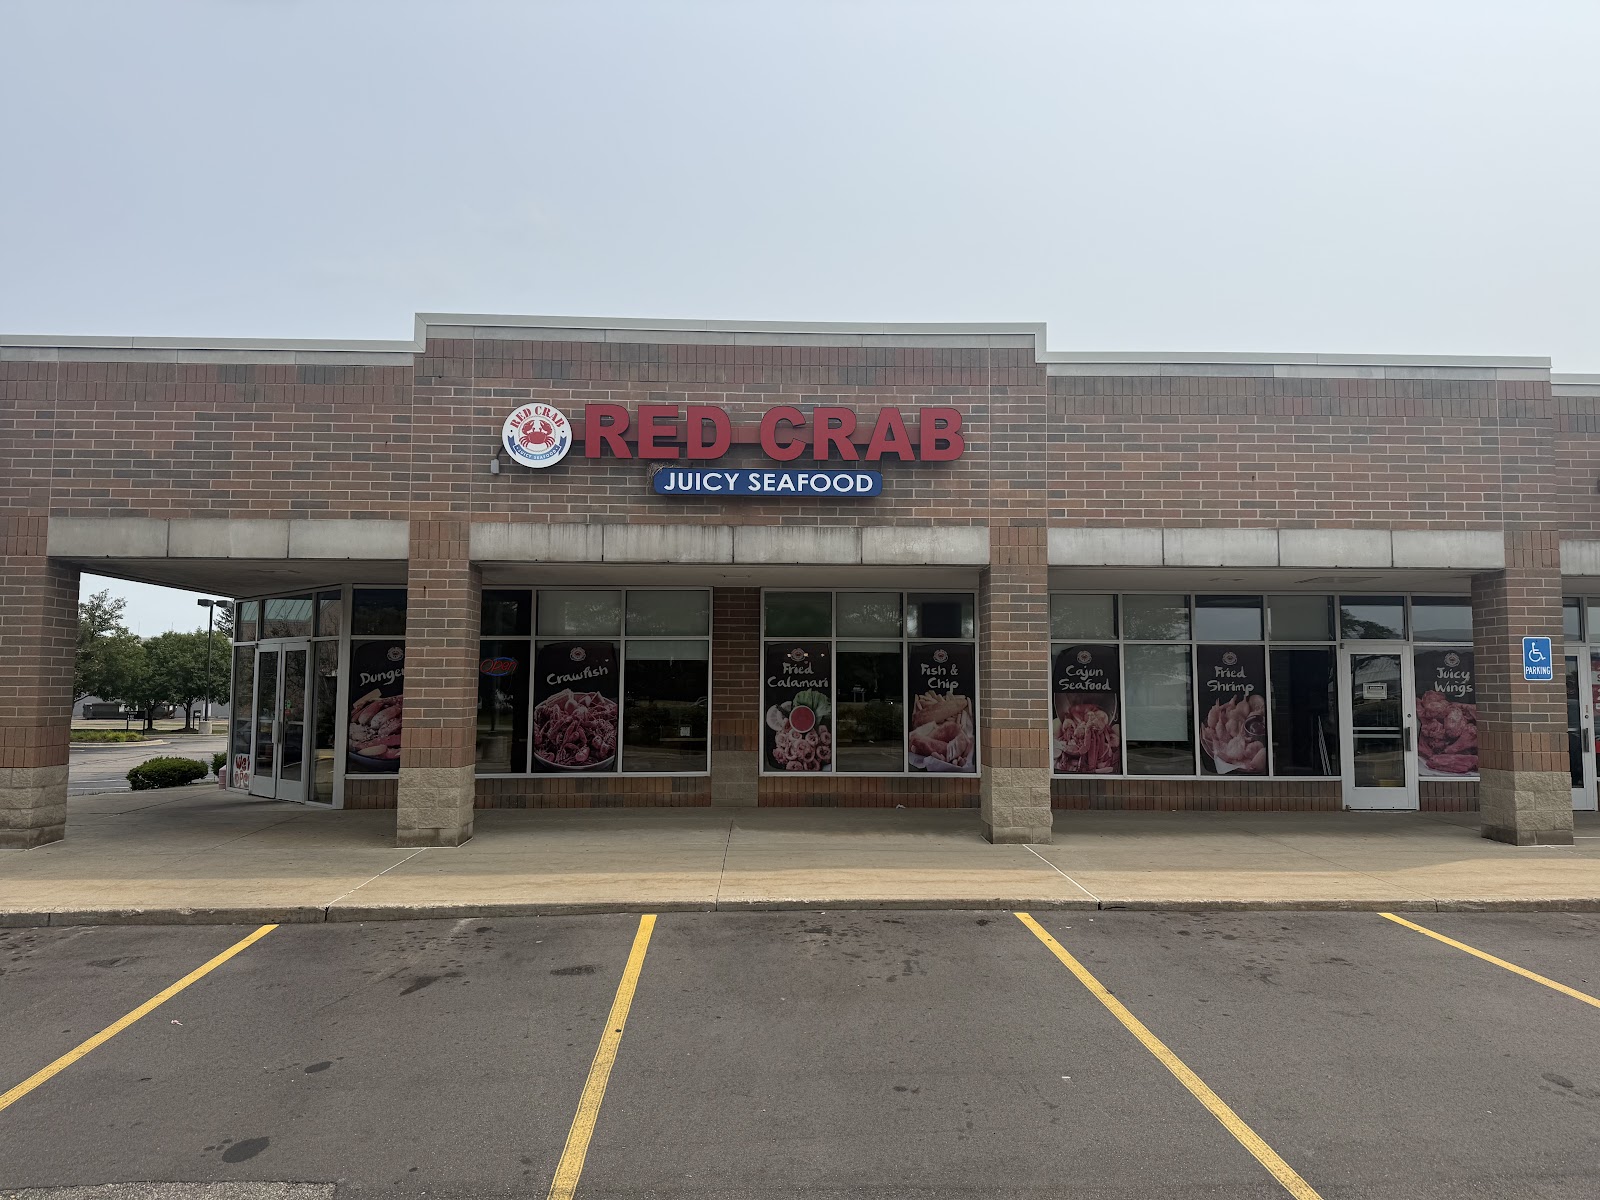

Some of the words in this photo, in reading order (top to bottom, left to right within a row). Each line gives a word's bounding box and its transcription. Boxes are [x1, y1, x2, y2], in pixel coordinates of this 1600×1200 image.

[510, 408, 532, 428] RED
[535, 406, 565, 428] CRAB
[584, 403, 732, 461] RED
[760, 405, 966, 462] CRAB
[518, 449, 532, 459] JUICY
[533, 449, 557, 460] SEAFOOD
[663, 471, 741, 492] JUICY
[747, 472, 875, 493] SEAFOOD
[546, 665, 609, 685] Crawfish
[782, 661, 815, 675] Fried
[920, 662, 947, 676] Fish
[950, 663, 959, 676] &
[1065, 664, 1104, 681] Cajun
[1214, 665, 1247, 678] Fried
[1436, 667, 1471, 684] Juicy
[1525, 666, 1551, 675] PARKING
[767, 675, 829, 688] Calamari
[927, 676, 960, 694] Chip
[1058, 677, 1112, 691] Seafood
[1206, 679, 1255, 696] Shrimp
[1434, 680, 1474, 698] Wings
